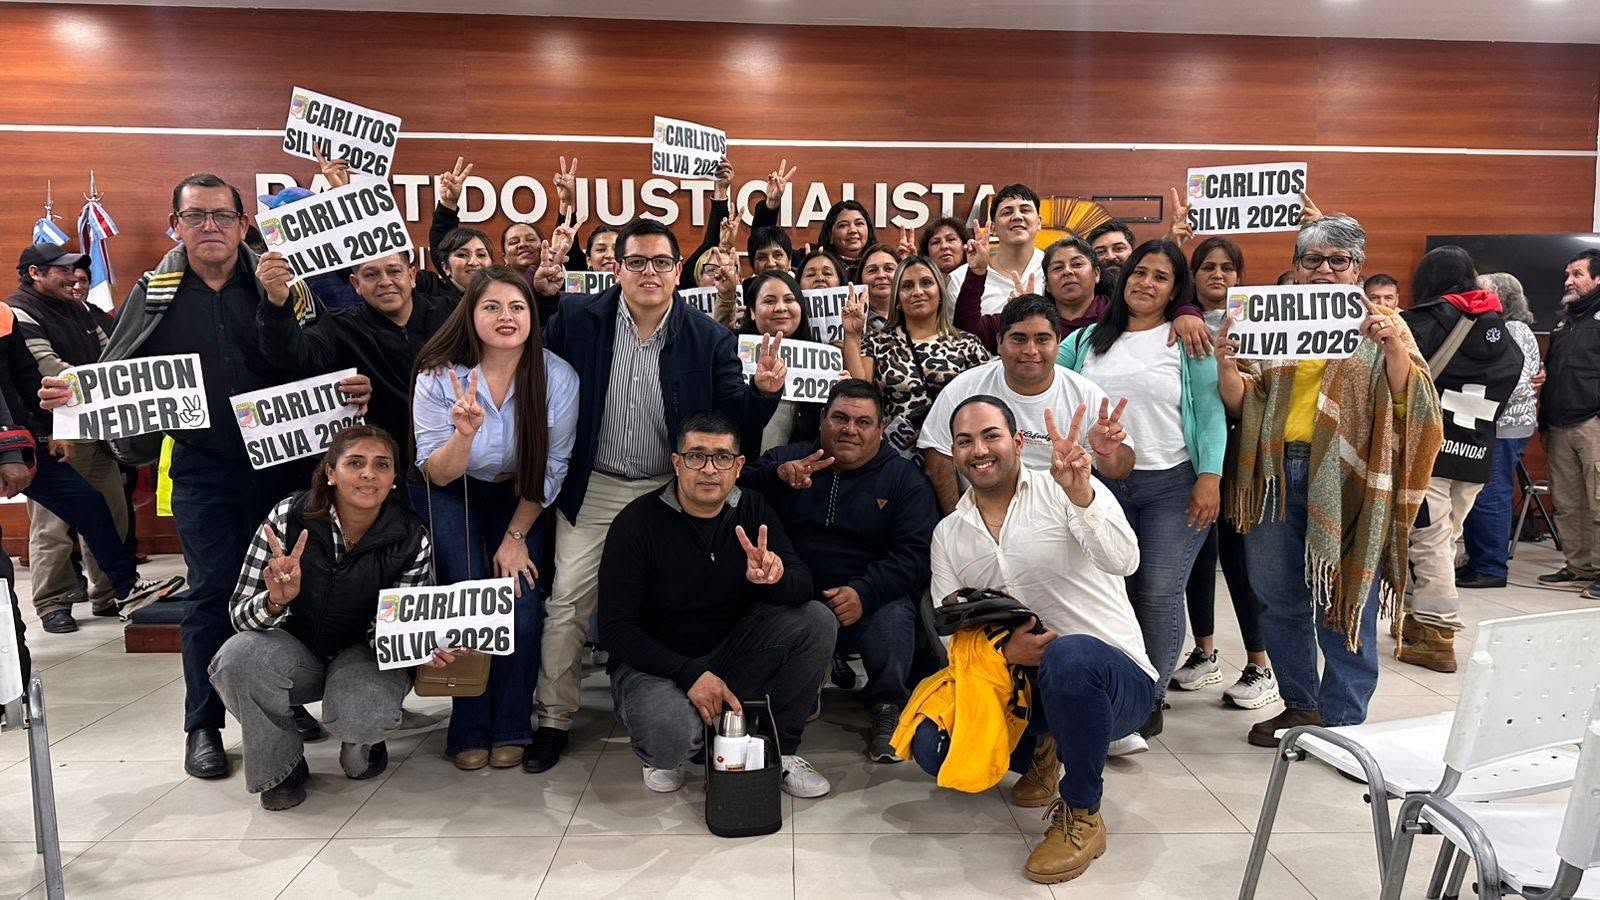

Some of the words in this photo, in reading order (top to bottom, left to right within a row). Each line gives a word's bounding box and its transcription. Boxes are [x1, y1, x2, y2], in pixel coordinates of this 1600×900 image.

[305, 100, 397, 147] CARLITOS
[665, 125, 726, 155] CARLITOS
[284, 127, 332, 162] SILVA
[338, 143, 389, 177] 2026
[653, 151, 689, 175] SILVA
[1205, 169, 1305, 199] CARLITOS
[280, 183, 395, 242] CARLITOS
[1187, 206, 1240, 231] SILVA
[1246, 203, 1301, 229] 2026
[343, 221, 407, 262] 2026
[1248, 291, 1363, 323] CARLITOS
[1296, 328, 1359, 354] 2026
[77, 358, 197, 404] PICHON
[78, 397, 181, 440] NEDER
[256, 380, 358, 427] CARLITO
[247, 428, 312, 466] SILVA
[1440, 439, 1487, 460] RDAVIDAS
[399, 586, 513, 622] CARLITOS
[377, 630, 438, 664] SILVA
[445, 626, 510, 651] 2026
